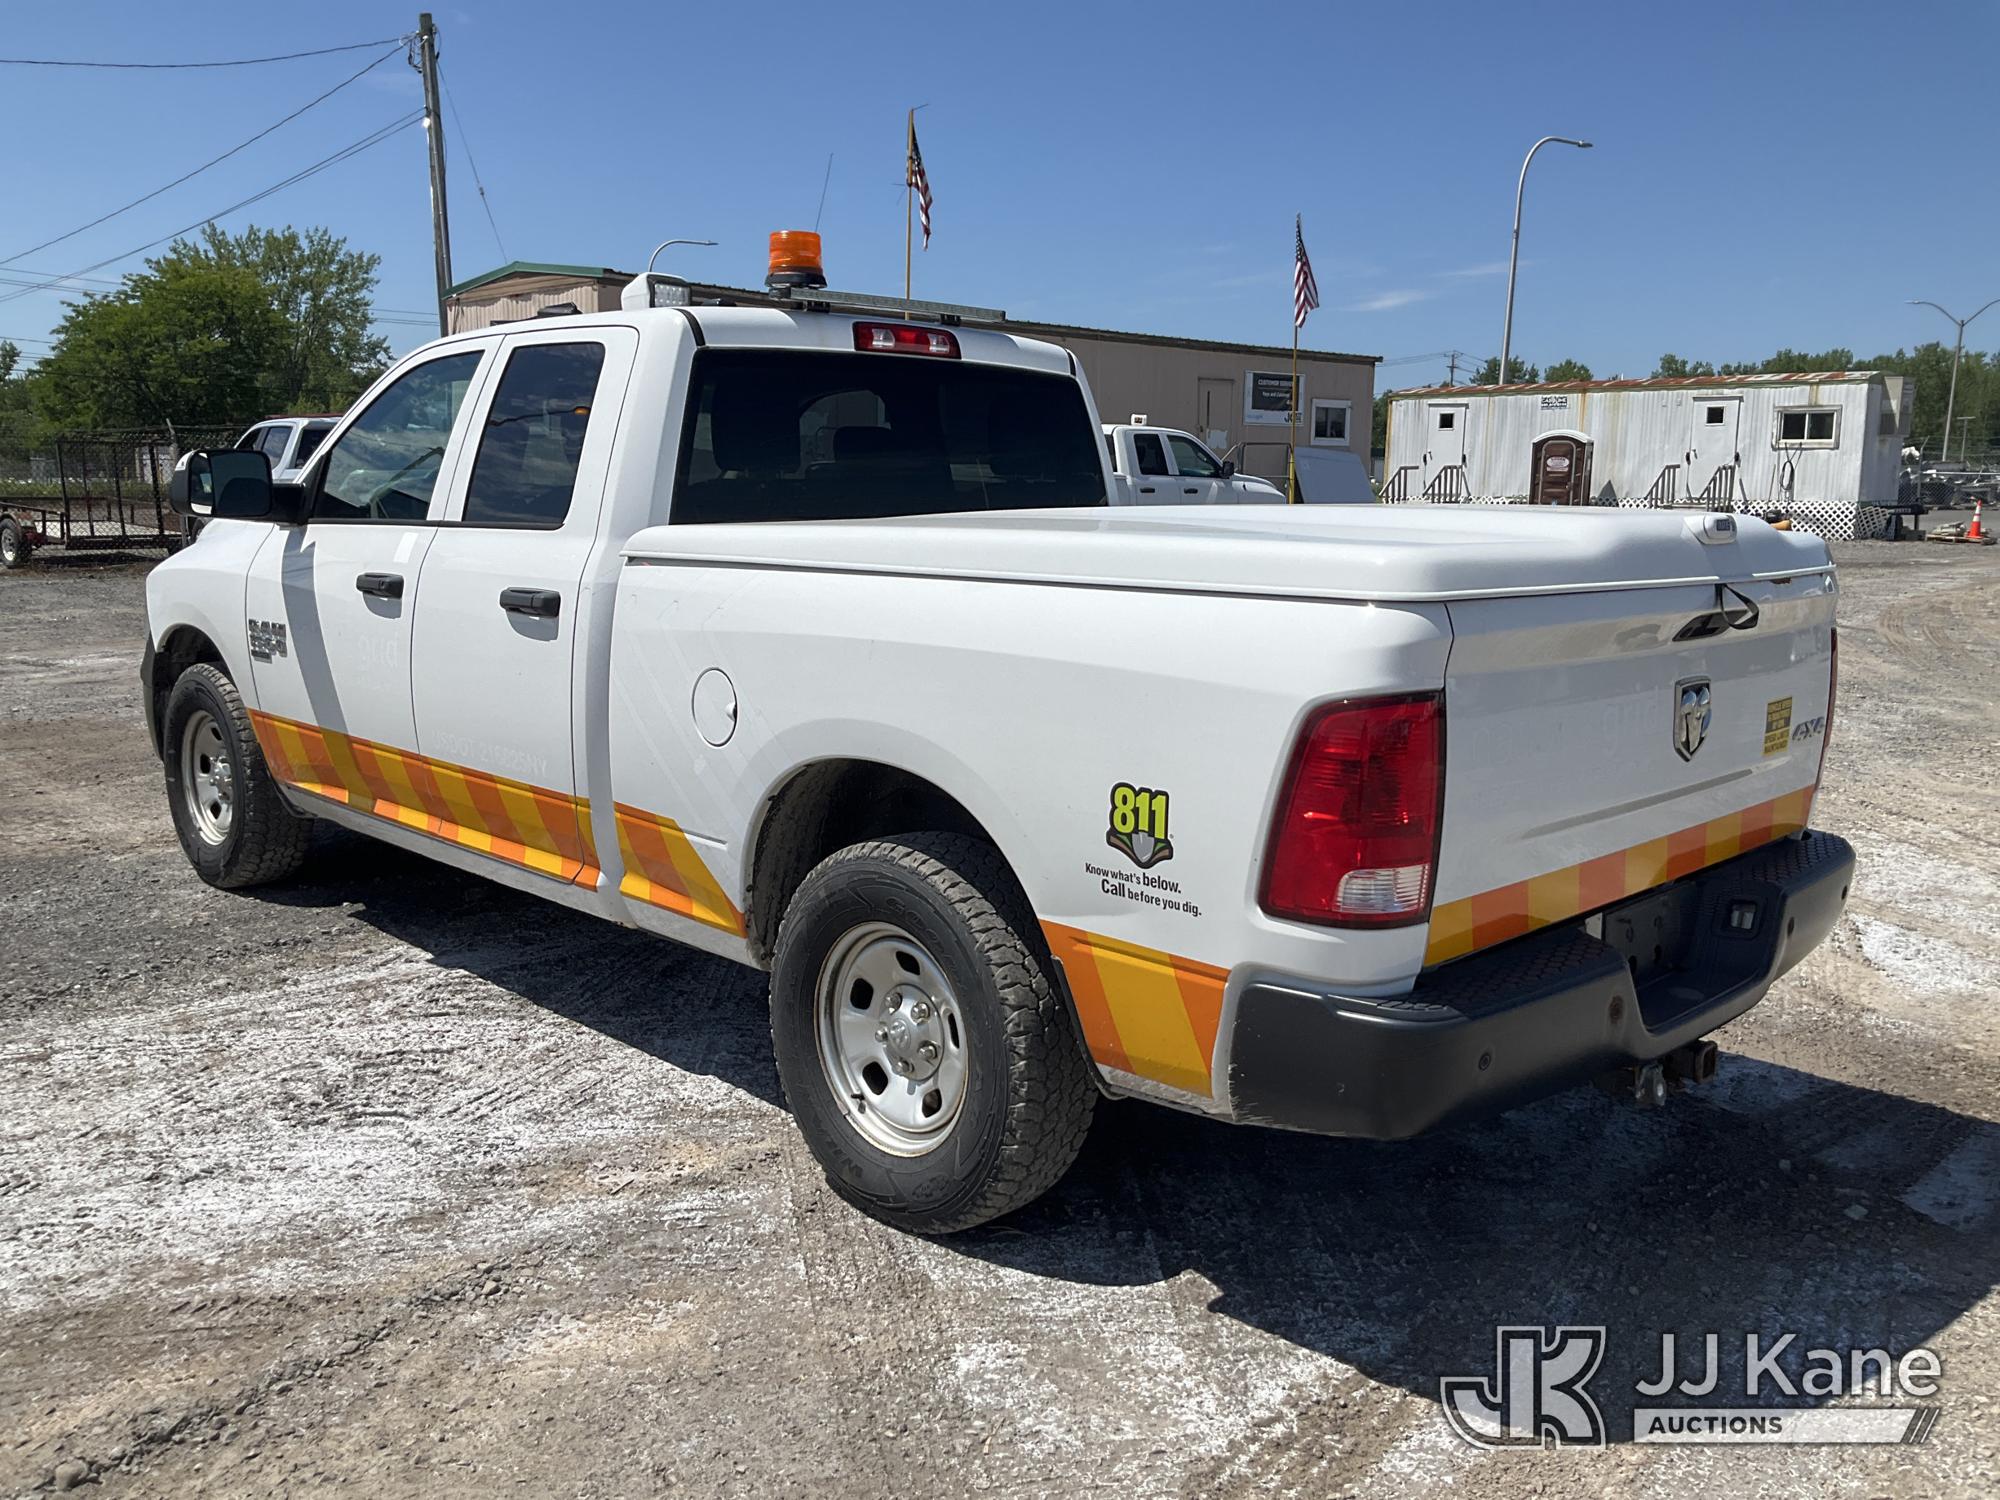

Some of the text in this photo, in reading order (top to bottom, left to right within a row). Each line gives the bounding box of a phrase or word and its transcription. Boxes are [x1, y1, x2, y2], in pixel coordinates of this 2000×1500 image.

[1112, 785, 1167, 840] 811
[1085, 861, 1182, 895] Know what's below.
[1101, 878, 1202, 917] Call before you dig.
